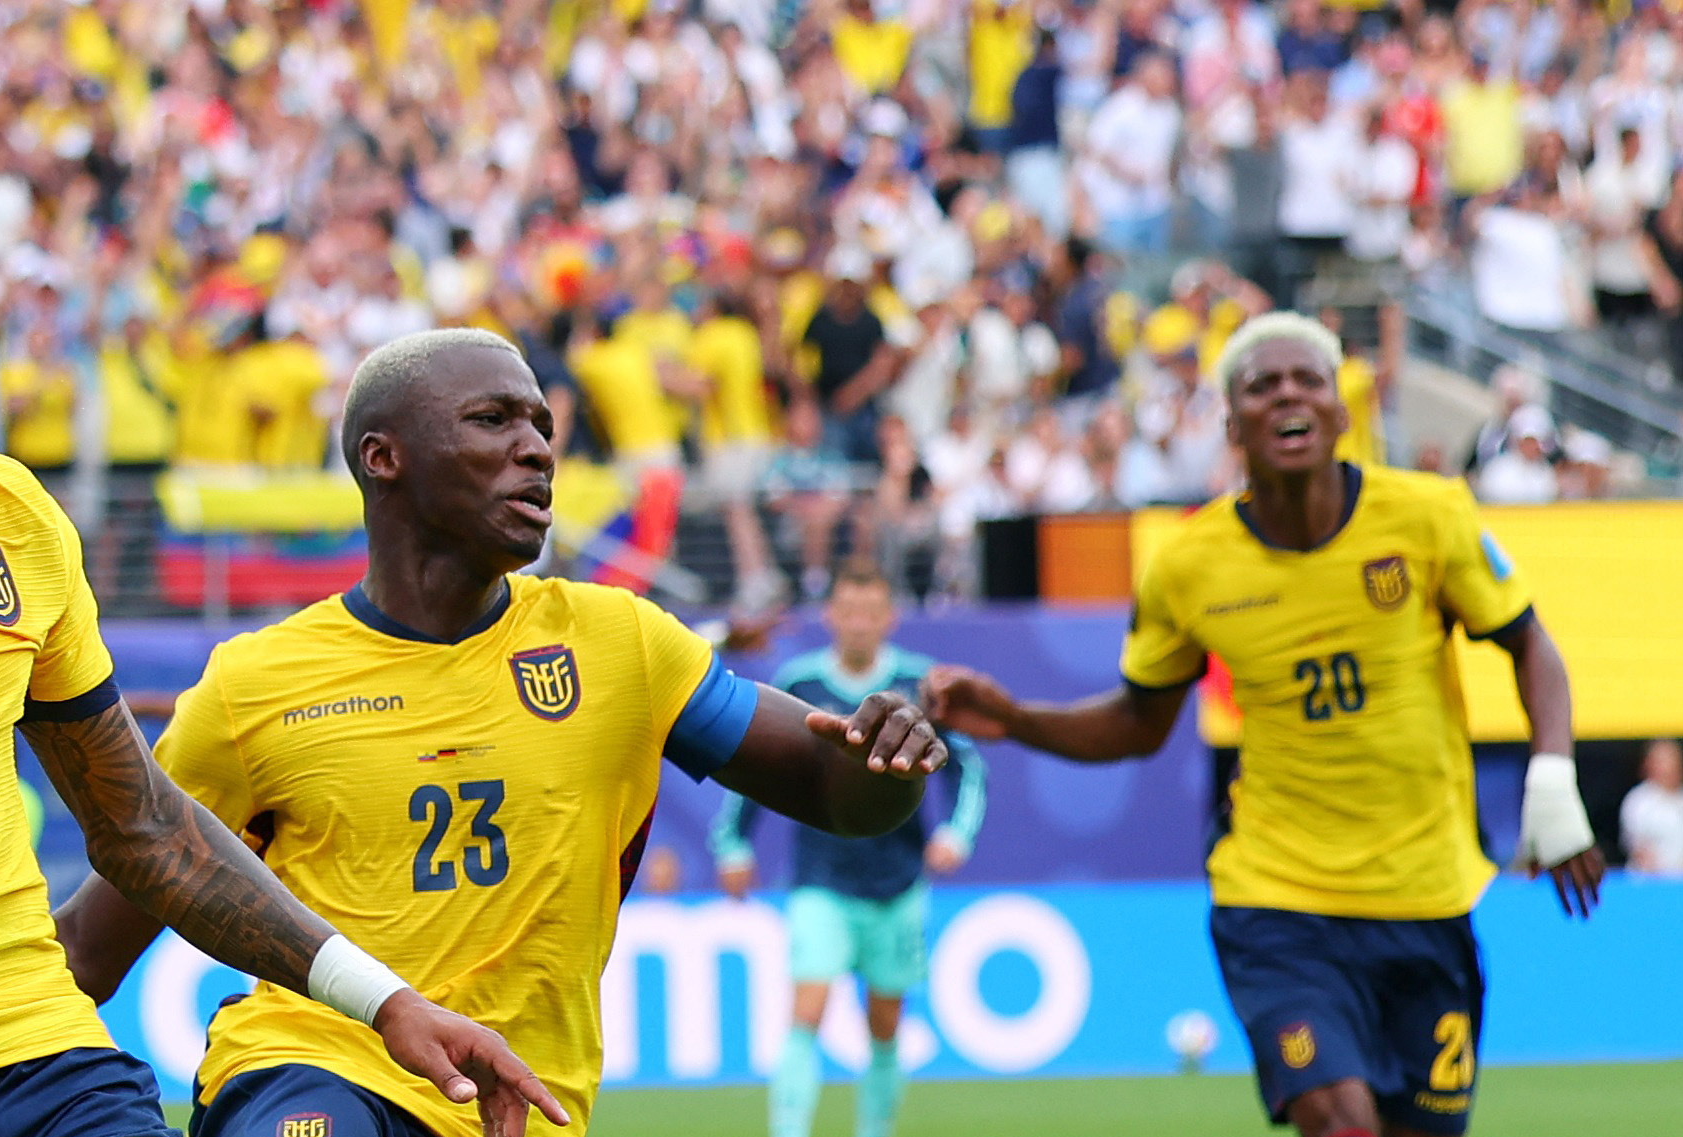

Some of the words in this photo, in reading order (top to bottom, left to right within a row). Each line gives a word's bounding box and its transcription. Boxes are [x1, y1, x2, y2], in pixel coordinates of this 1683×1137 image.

[283, 695, 405, 726] marathon
[1295, 651, 1366, 721] 20
[408, 779, 510, 893] 23
